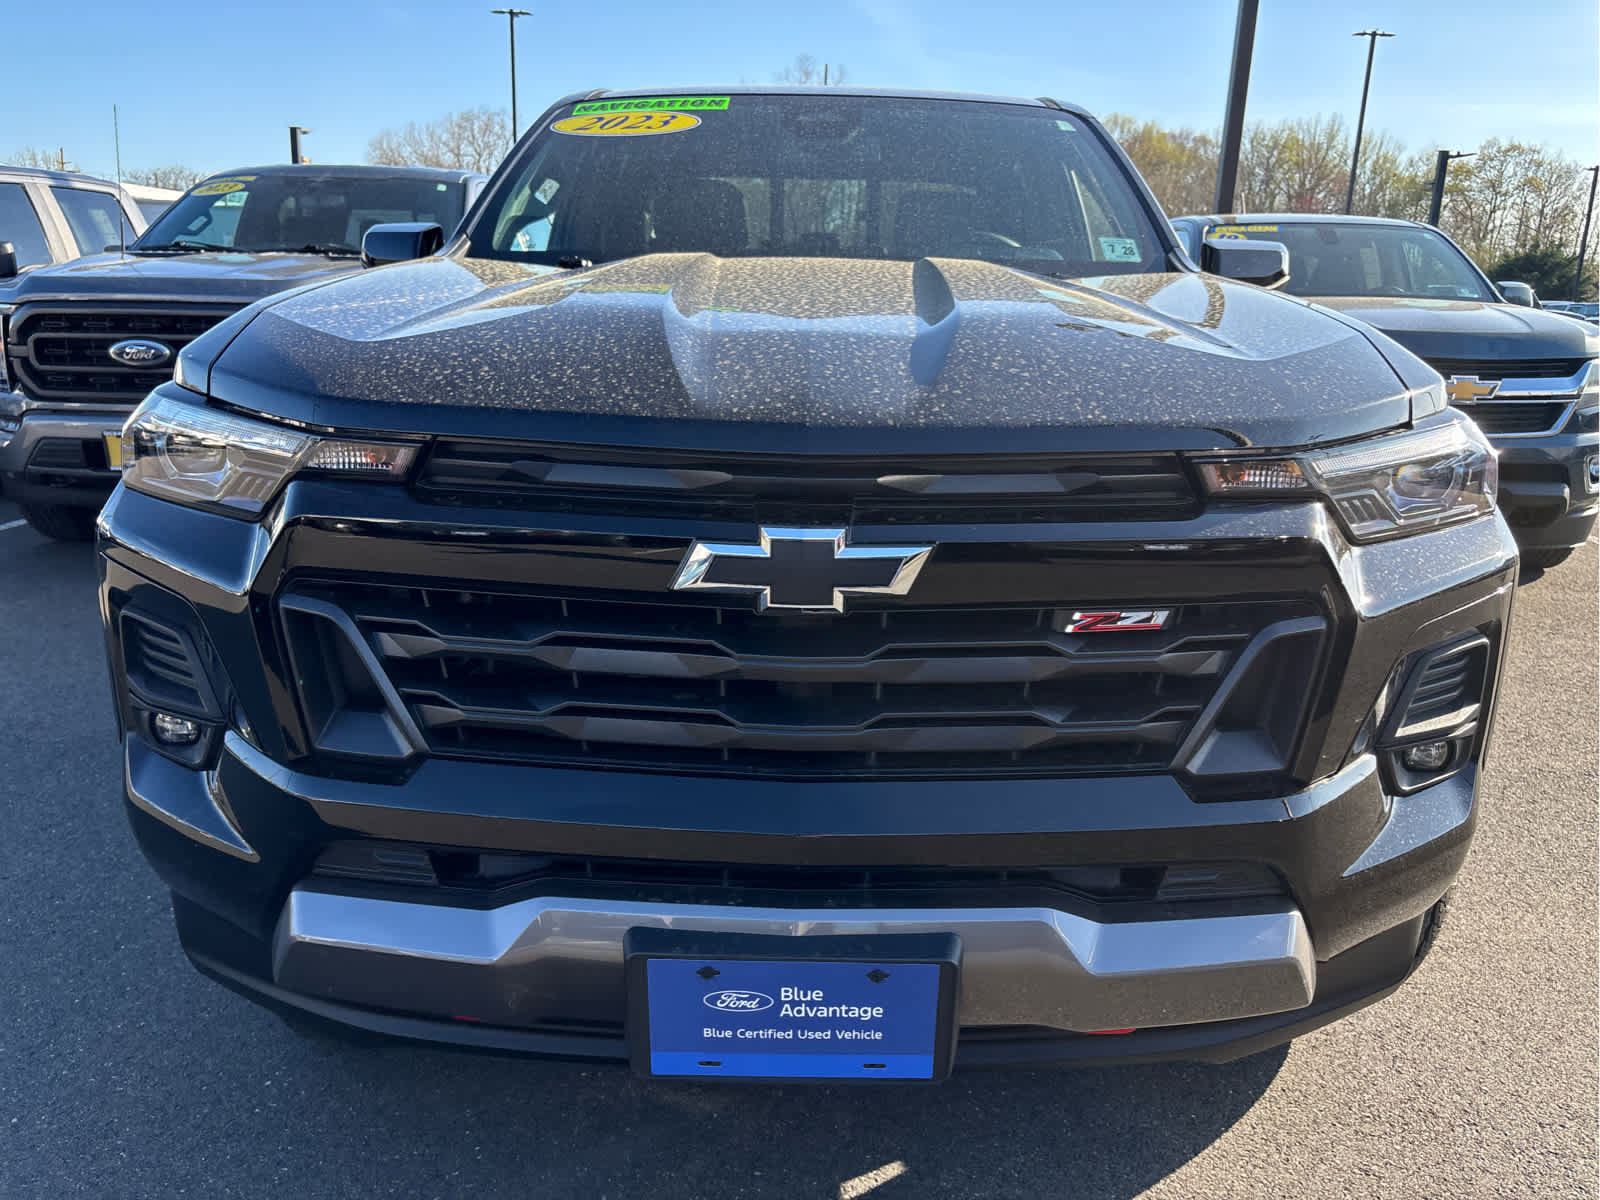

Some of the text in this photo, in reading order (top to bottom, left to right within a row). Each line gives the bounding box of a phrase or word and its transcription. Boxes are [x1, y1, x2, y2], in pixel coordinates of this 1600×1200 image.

[576, 99, 727, 114] NAVIGATION
[573, 115, 678, 131] 2023
[1107, 244, 1136, 256] 7 28
[1064, 610, 1170, 633] Z71
[716, 992, 761, 1010] Ford
[780, 987, 824, 1001] Blue
[779, 1003, 884, 1020] Advantage
[703, 1027, 883, 1041] Blue Certified Used Vehicle
